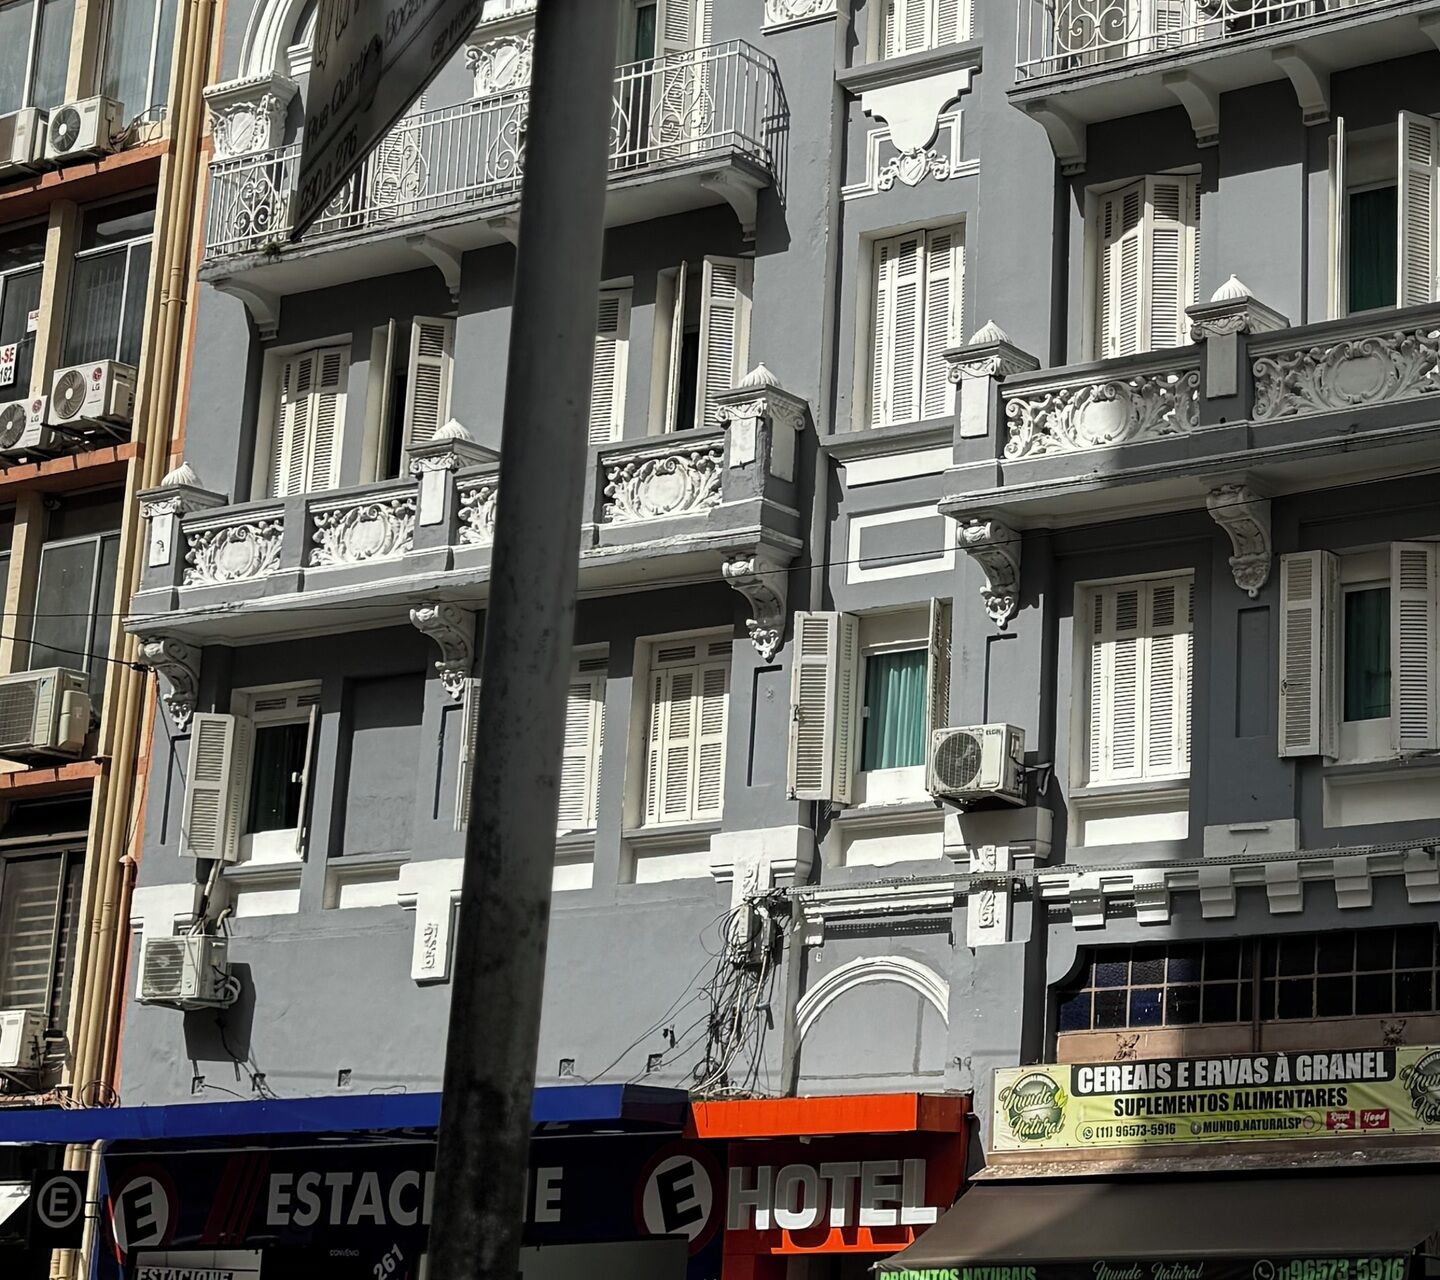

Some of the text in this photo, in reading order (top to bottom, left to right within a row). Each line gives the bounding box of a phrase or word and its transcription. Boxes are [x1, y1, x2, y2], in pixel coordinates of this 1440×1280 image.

[1077, 1062, 1172, 1094] CEREAIS
[1177, 1061, 1189, 1087] E
[1194, 1057, 1270, 1087] ERVAS
[1273, 1050, 1292, 1084] À
[1295, 1049, 1388, 1082] GRANEL
[999, 1085, 1054, 1114] Mundo
[1114, 1087, 1348, 1117] SUPLEMENTOS ALIMENTARES
[1008, 1114, 1066, 1143] Natural
[1096, 1125, 1113, 1138] (11)
[1115, 1123, 1176, 1138] 96573-5916
[50, 1187, 70, 1217] E
[727, 1158, 938, 1231] HOTEL
